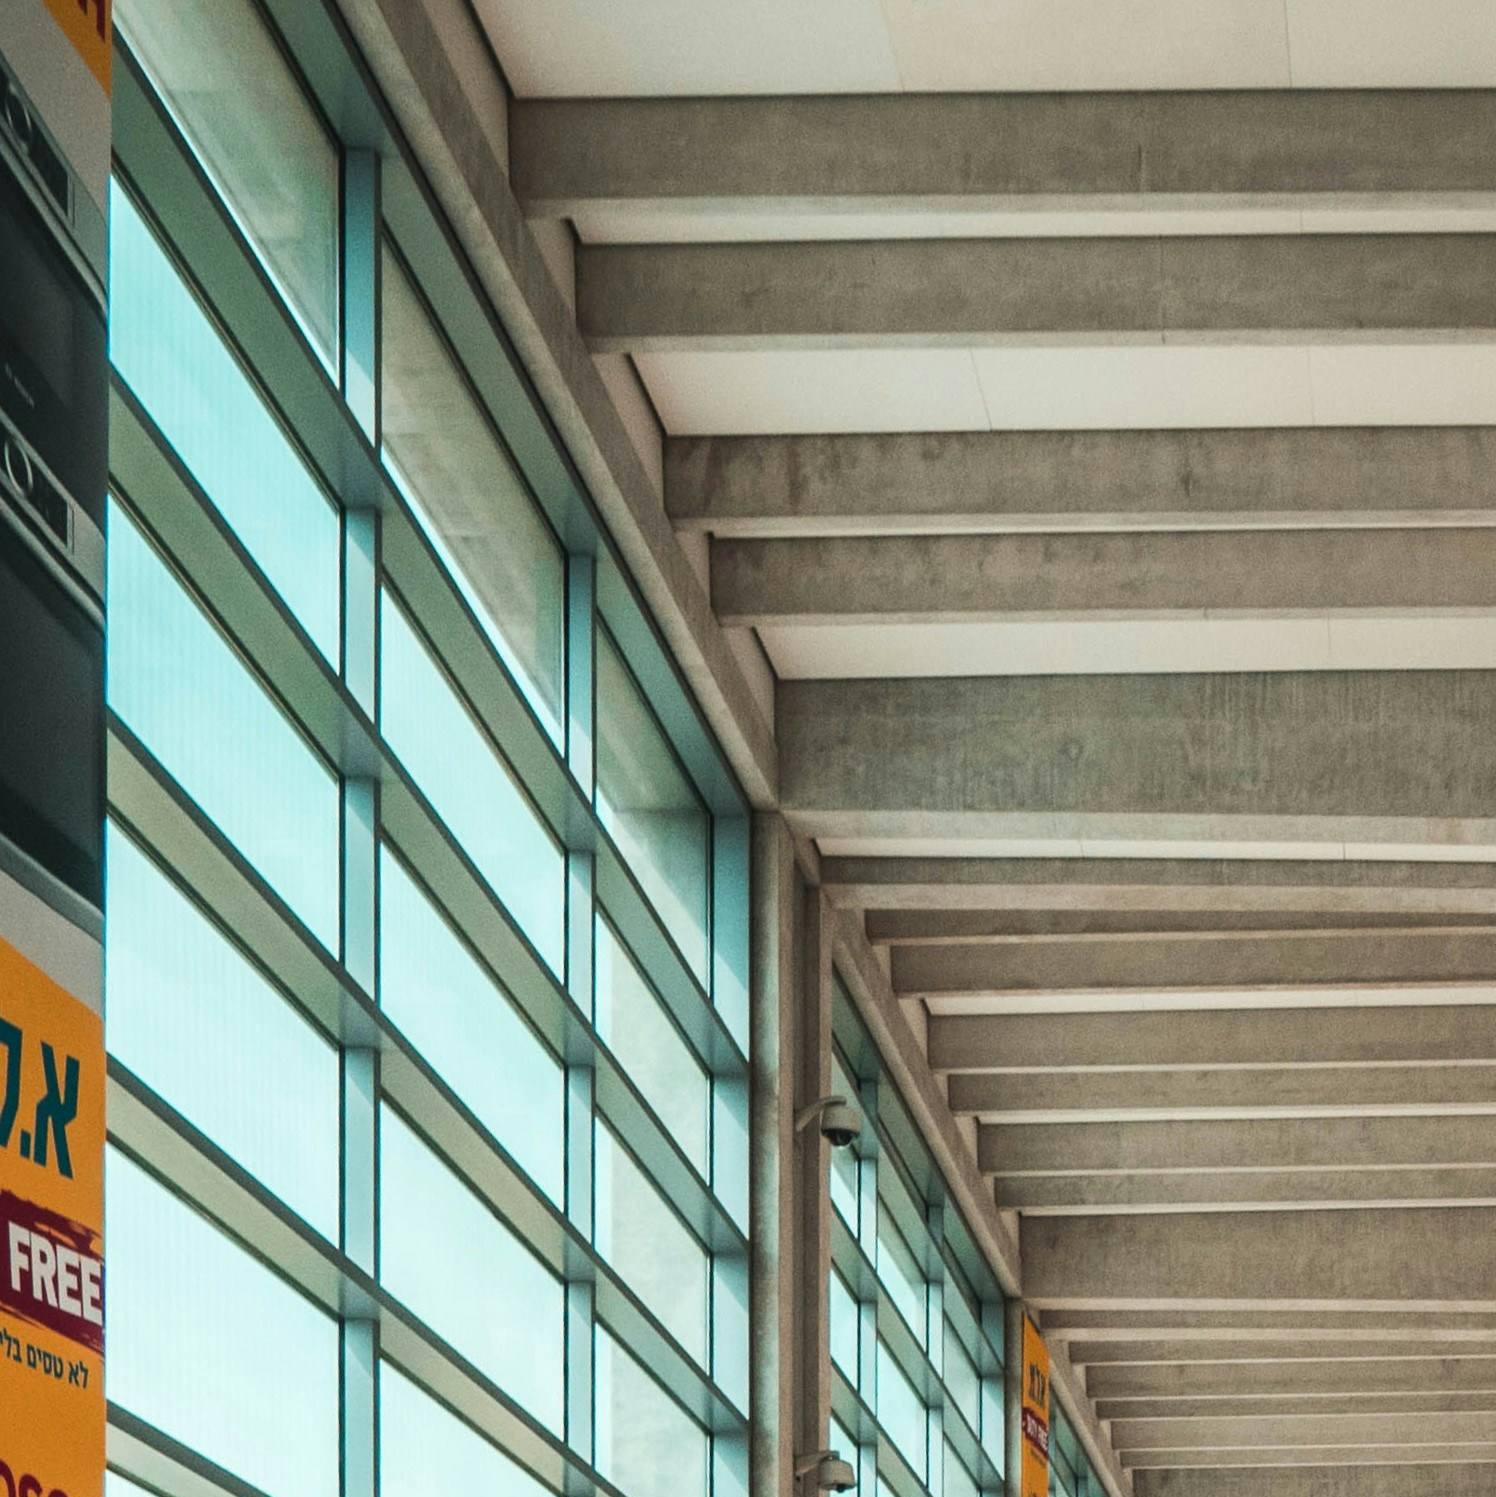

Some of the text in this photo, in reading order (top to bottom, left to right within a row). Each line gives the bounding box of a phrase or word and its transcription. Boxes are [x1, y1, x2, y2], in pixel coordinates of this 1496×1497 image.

[9, 1221, 103, 1326] FREE
[26, 1343, 64, 1379] טסים
[69, 1361, 89, 1389] לא
